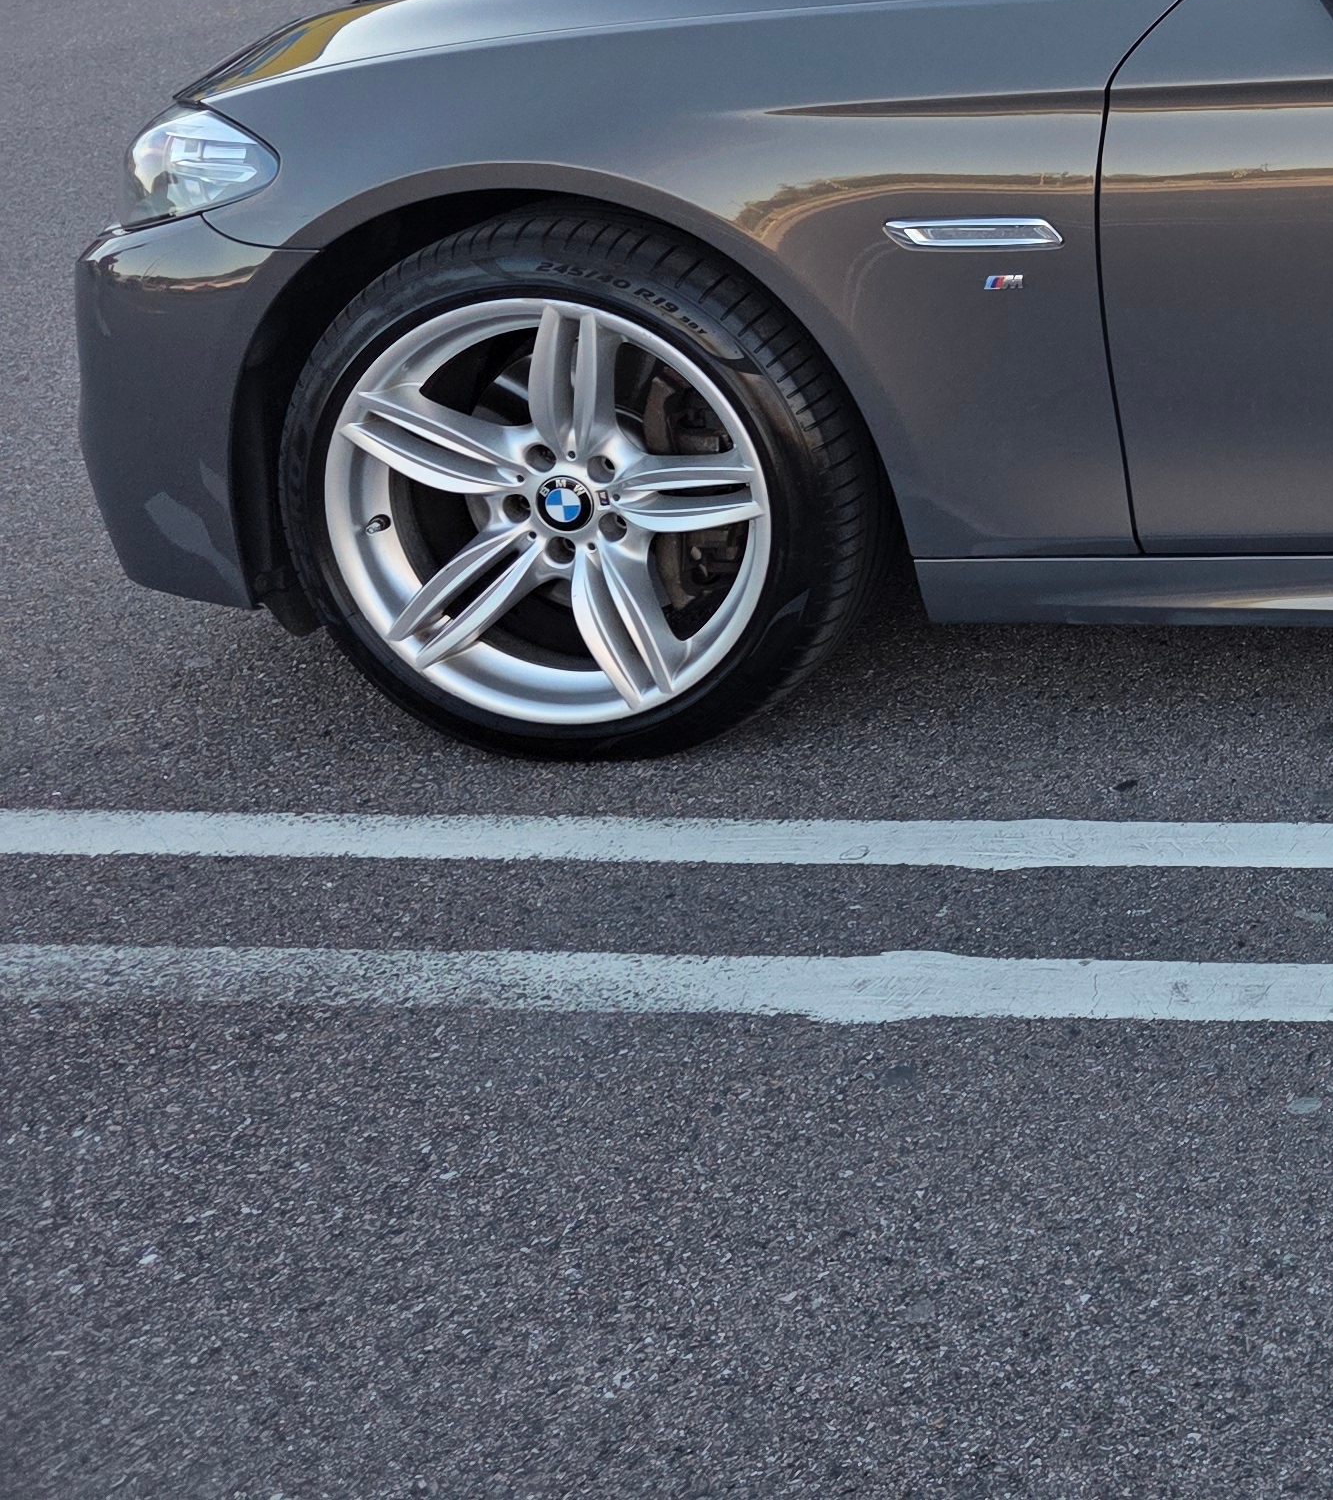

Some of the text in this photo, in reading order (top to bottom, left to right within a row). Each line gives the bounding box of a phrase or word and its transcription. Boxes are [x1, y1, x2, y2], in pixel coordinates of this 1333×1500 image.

[535, 261, 631, 290] 245/40
[633, 287, 680, 313] R19
[540, 478, 587, 498] BMW
